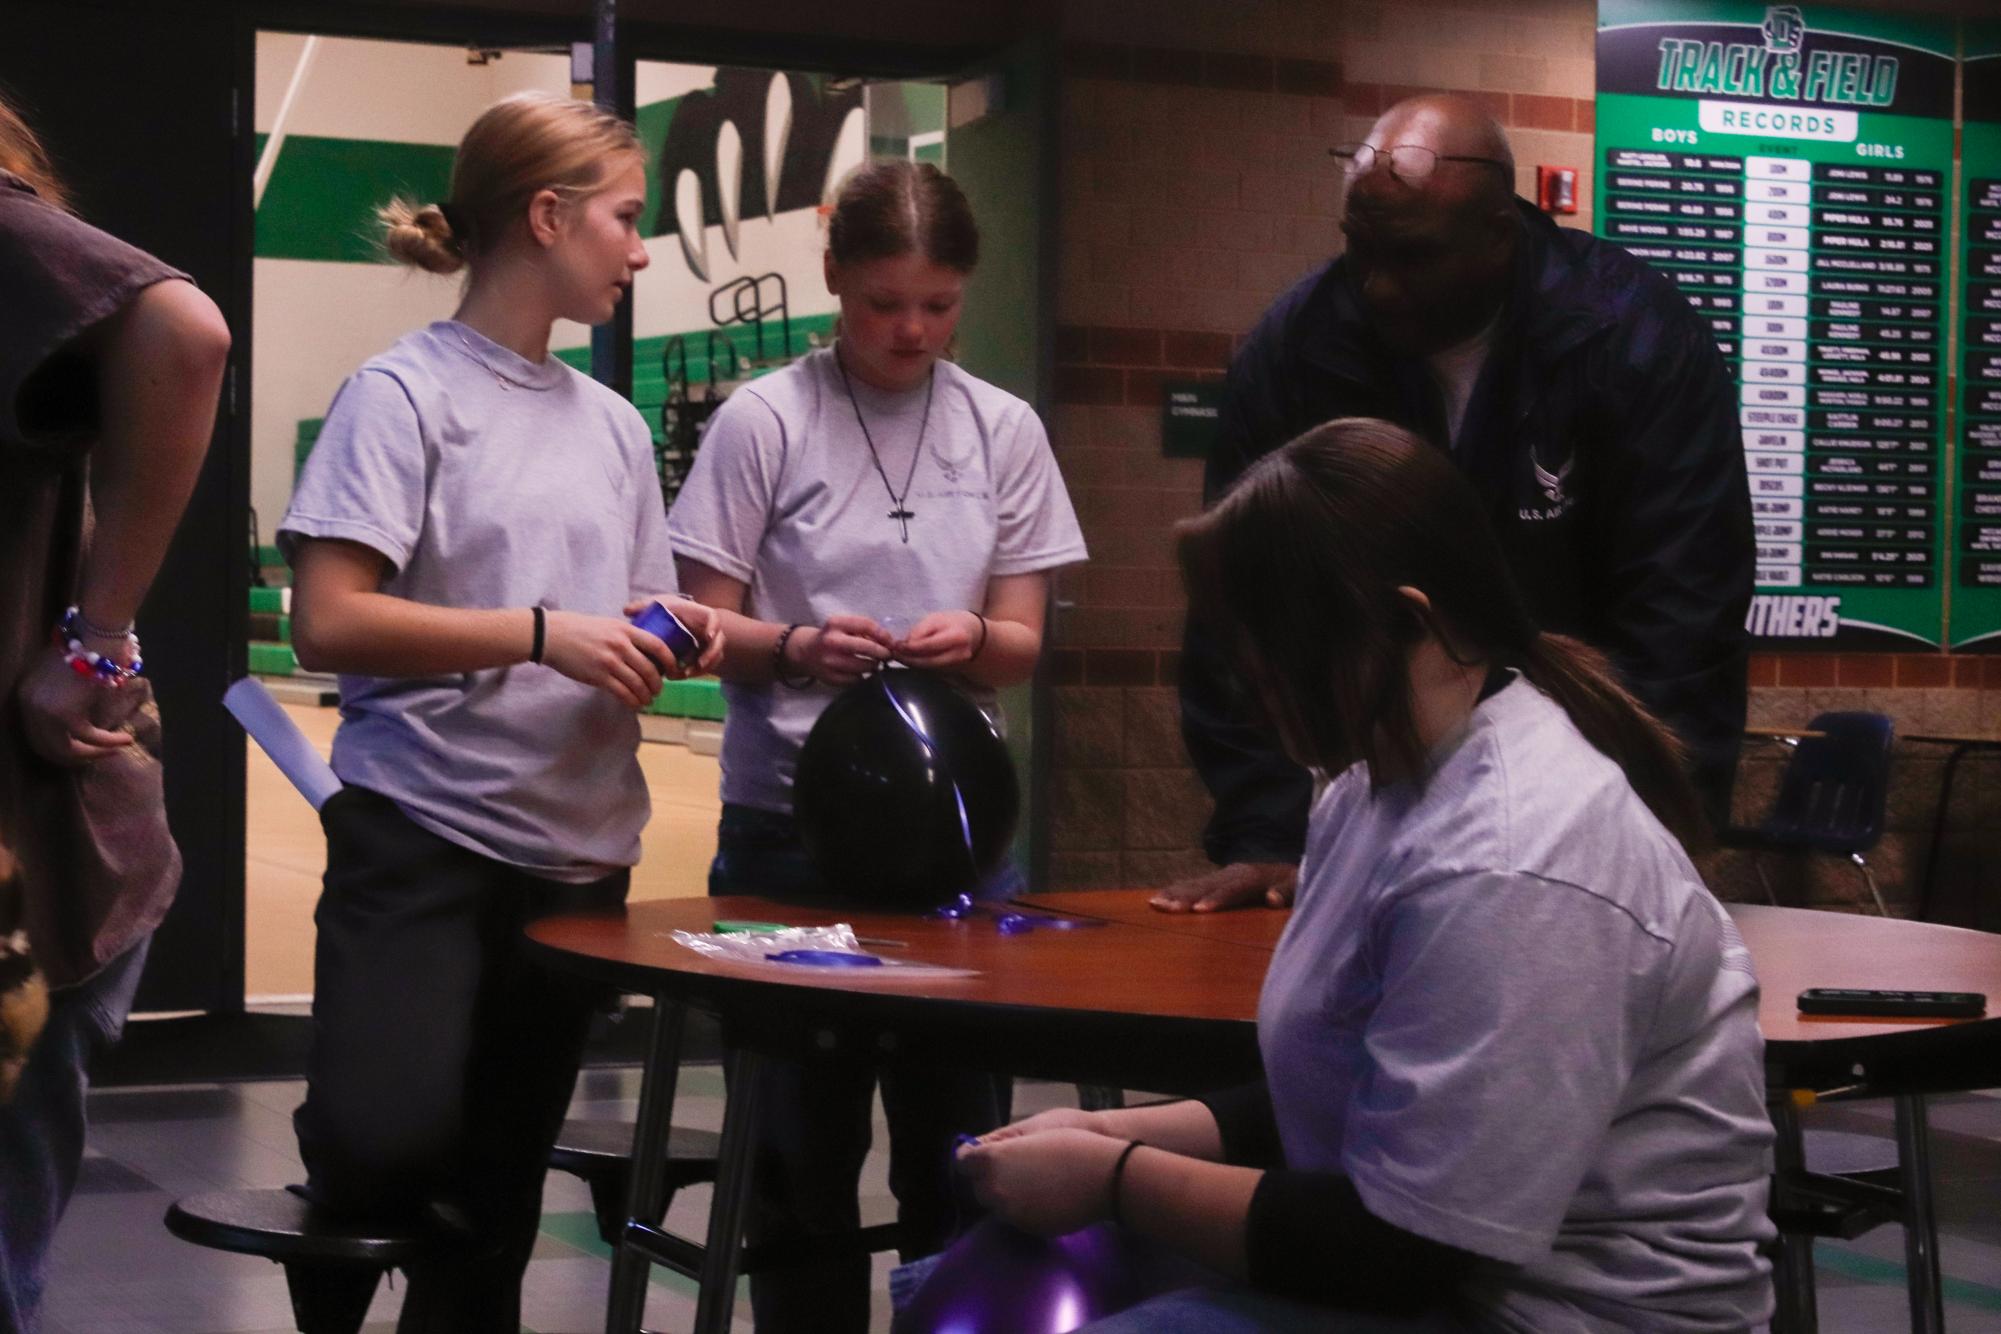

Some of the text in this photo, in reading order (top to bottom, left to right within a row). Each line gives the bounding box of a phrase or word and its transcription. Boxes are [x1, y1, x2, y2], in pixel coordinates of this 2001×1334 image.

[1657, 38, 1898, 107] TRACK & FIELD
[1723, 110, 1836, 135] RECORDS
[1651, 128, 1698, 144] BOYS
[1759, 143, 1798, 154] EVENT
[1856, 143, 1905, 159] GIRLS
[1171, 392, 1198, 402] MAIN
